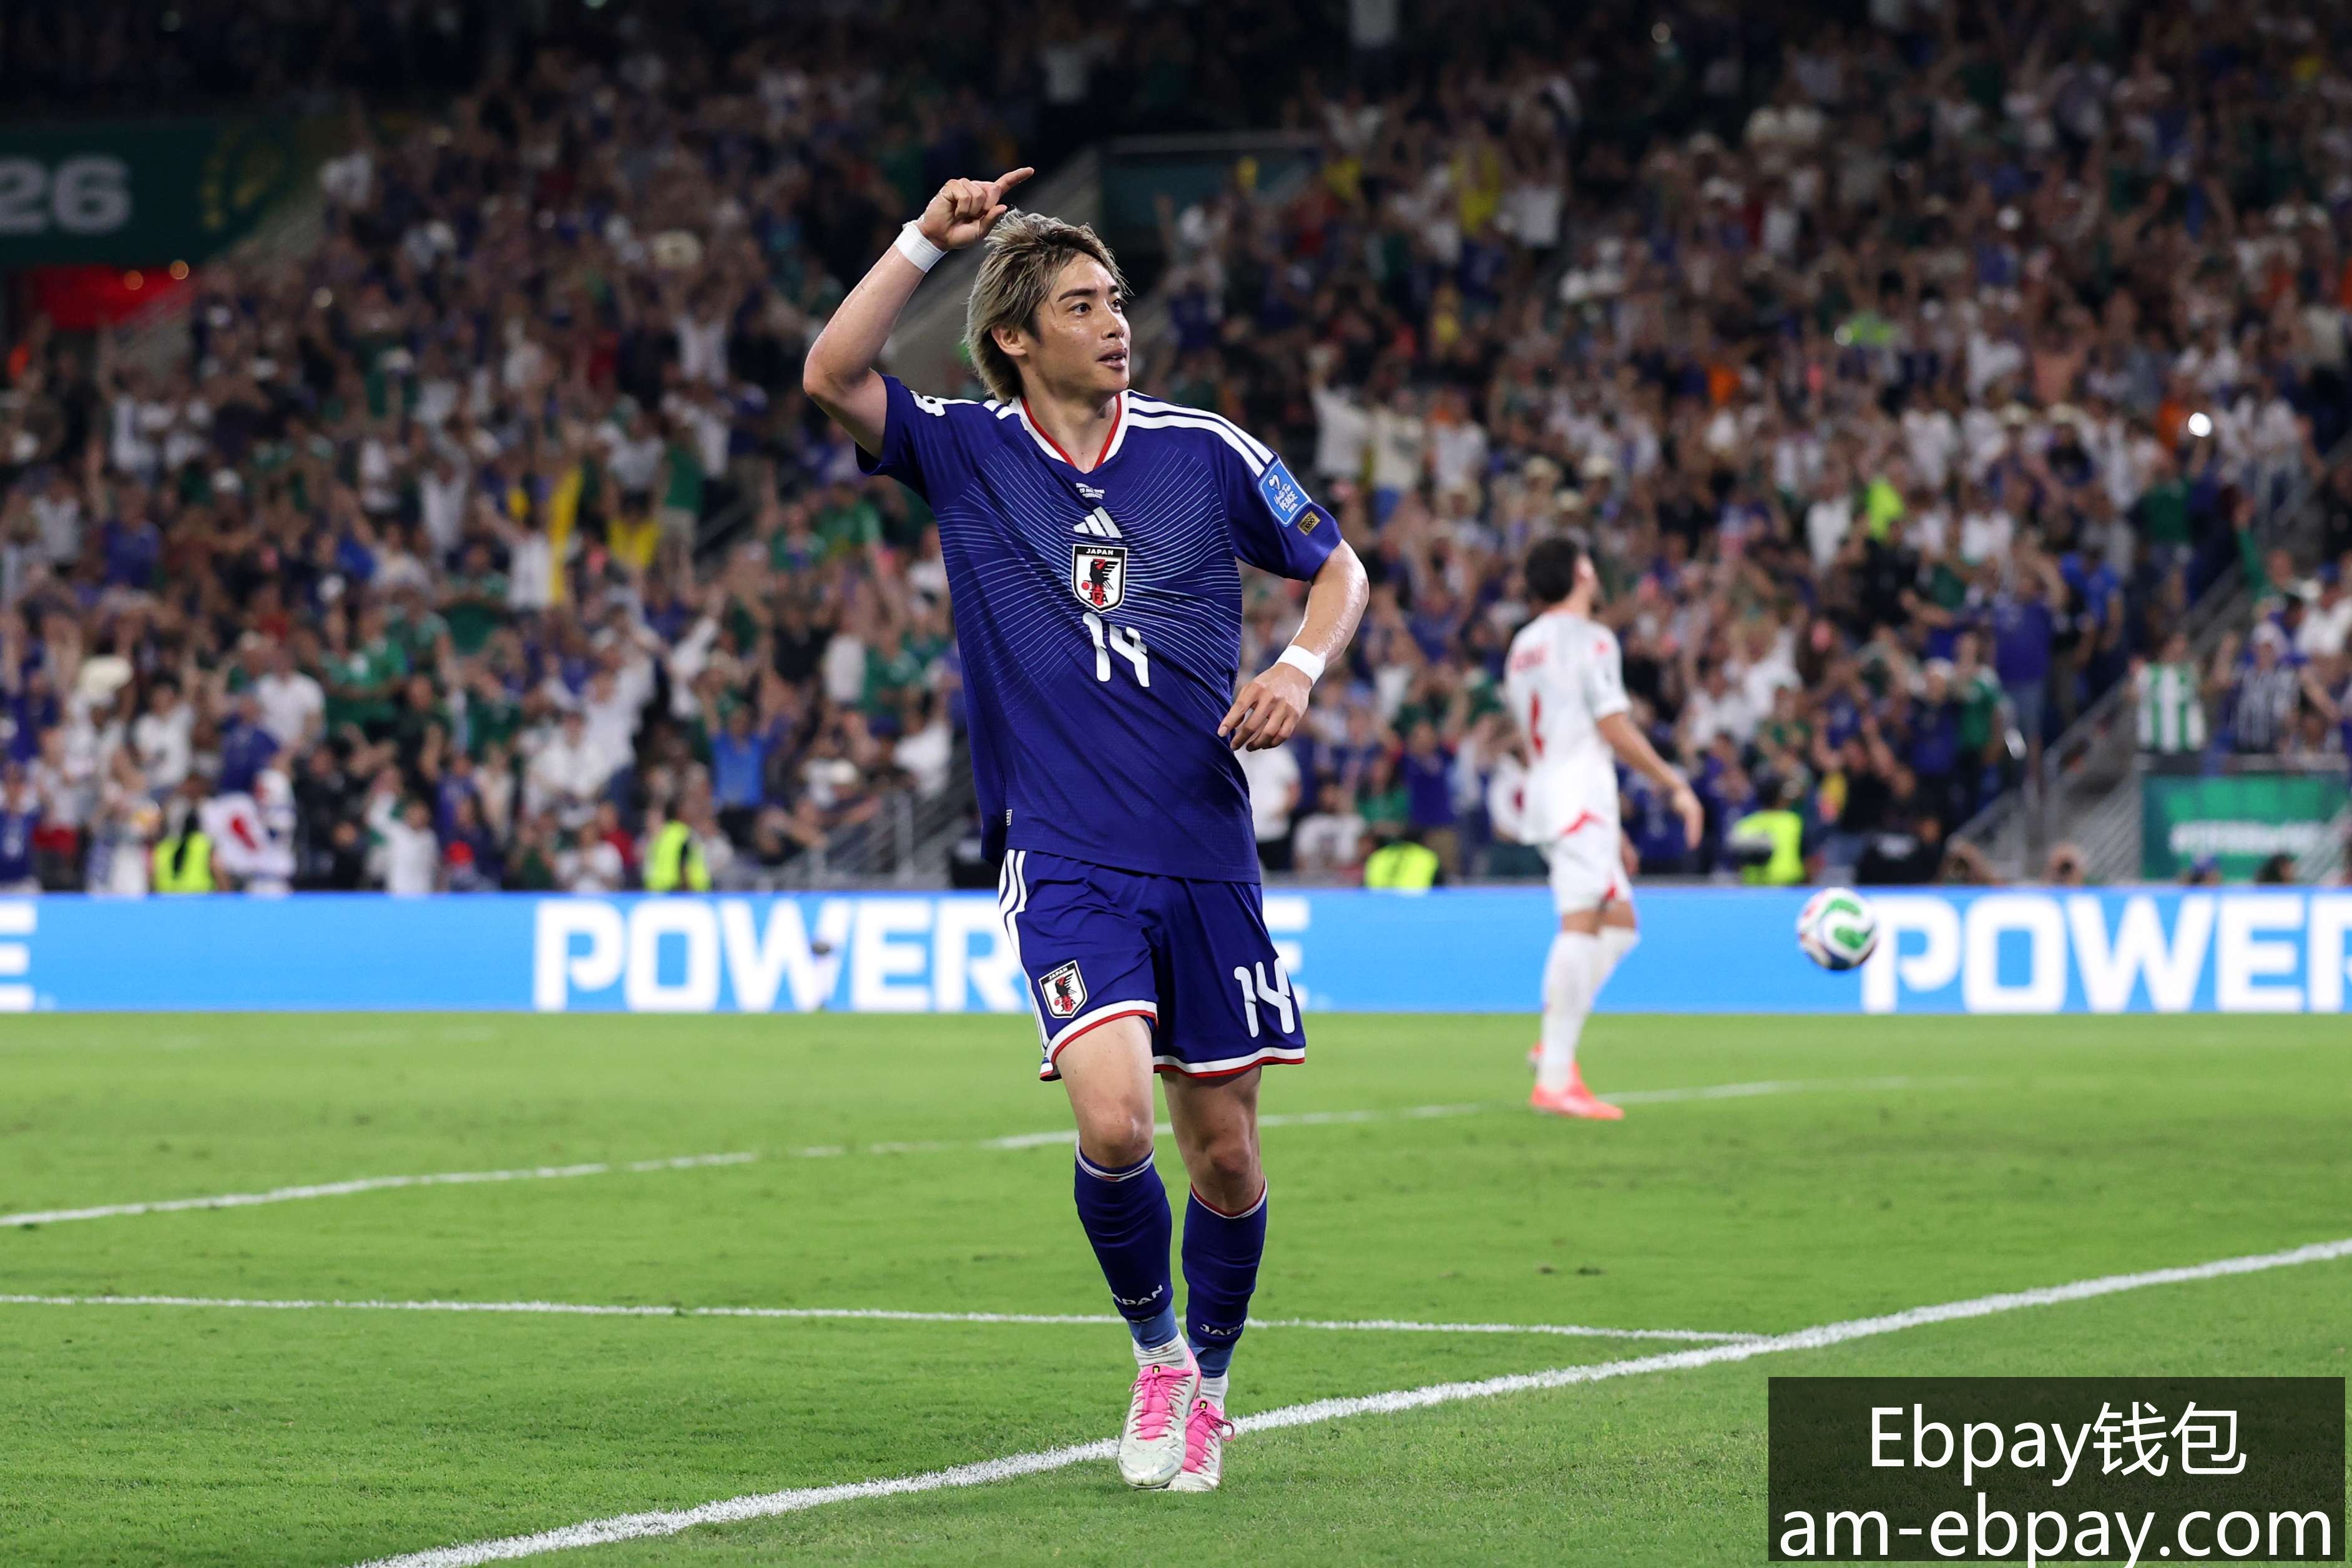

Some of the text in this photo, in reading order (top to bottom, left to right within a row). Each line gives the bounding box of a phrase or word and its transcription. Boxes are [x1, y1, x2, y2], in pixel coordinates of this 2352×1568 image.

[1278, 490, 1298, 511] PEACE
[1087, 592, 1109, 603] JFA
[1082, 612, 1150, 687] 14
[1049, 967, 1068, 980] JAPAN
[1234, 957, 1295, 1038] 14
